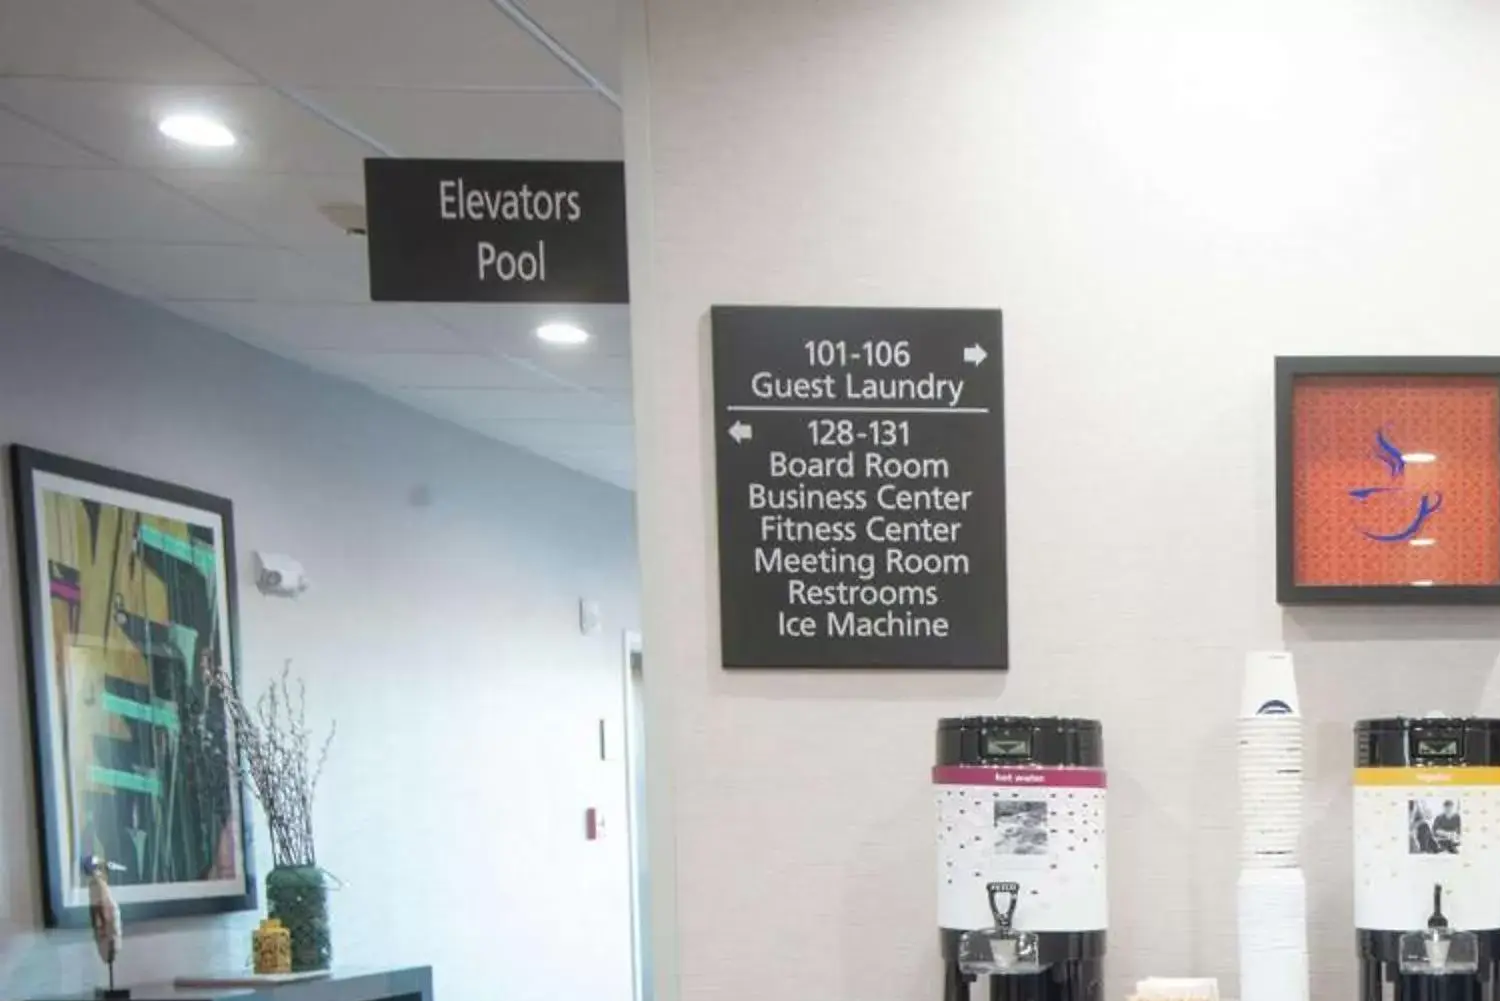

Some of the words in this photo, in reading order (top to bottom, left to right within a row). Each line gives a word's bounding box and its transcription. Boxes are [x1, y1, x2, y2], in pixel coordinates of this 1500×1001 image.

[439, 178, 581, 221] Elevators
[477, 239, 546, 282] Pool
[803, 339, 911, 368] 101-106
[751, 373, 836, 399] Guest
[845, 372, 964, 406] Laundry
[807, 418, 910, 447] 128-131
[769, 450, 855, 479] Board
[865, 451, 950, 479] Room
[748, 482, 868, 511] Business
[876, 483, 974, 511] Center
[760, 514, 857, 543] Fitness
[865, 515, 962, 543] Center
[754, 547, 875, 578] Meeting
[886, 547, 970, 575] Room
[788, 579, 939, 607] Restrooms
[777, 609, 817, 638] Ice
[827, 609, 950, 638] Machine
